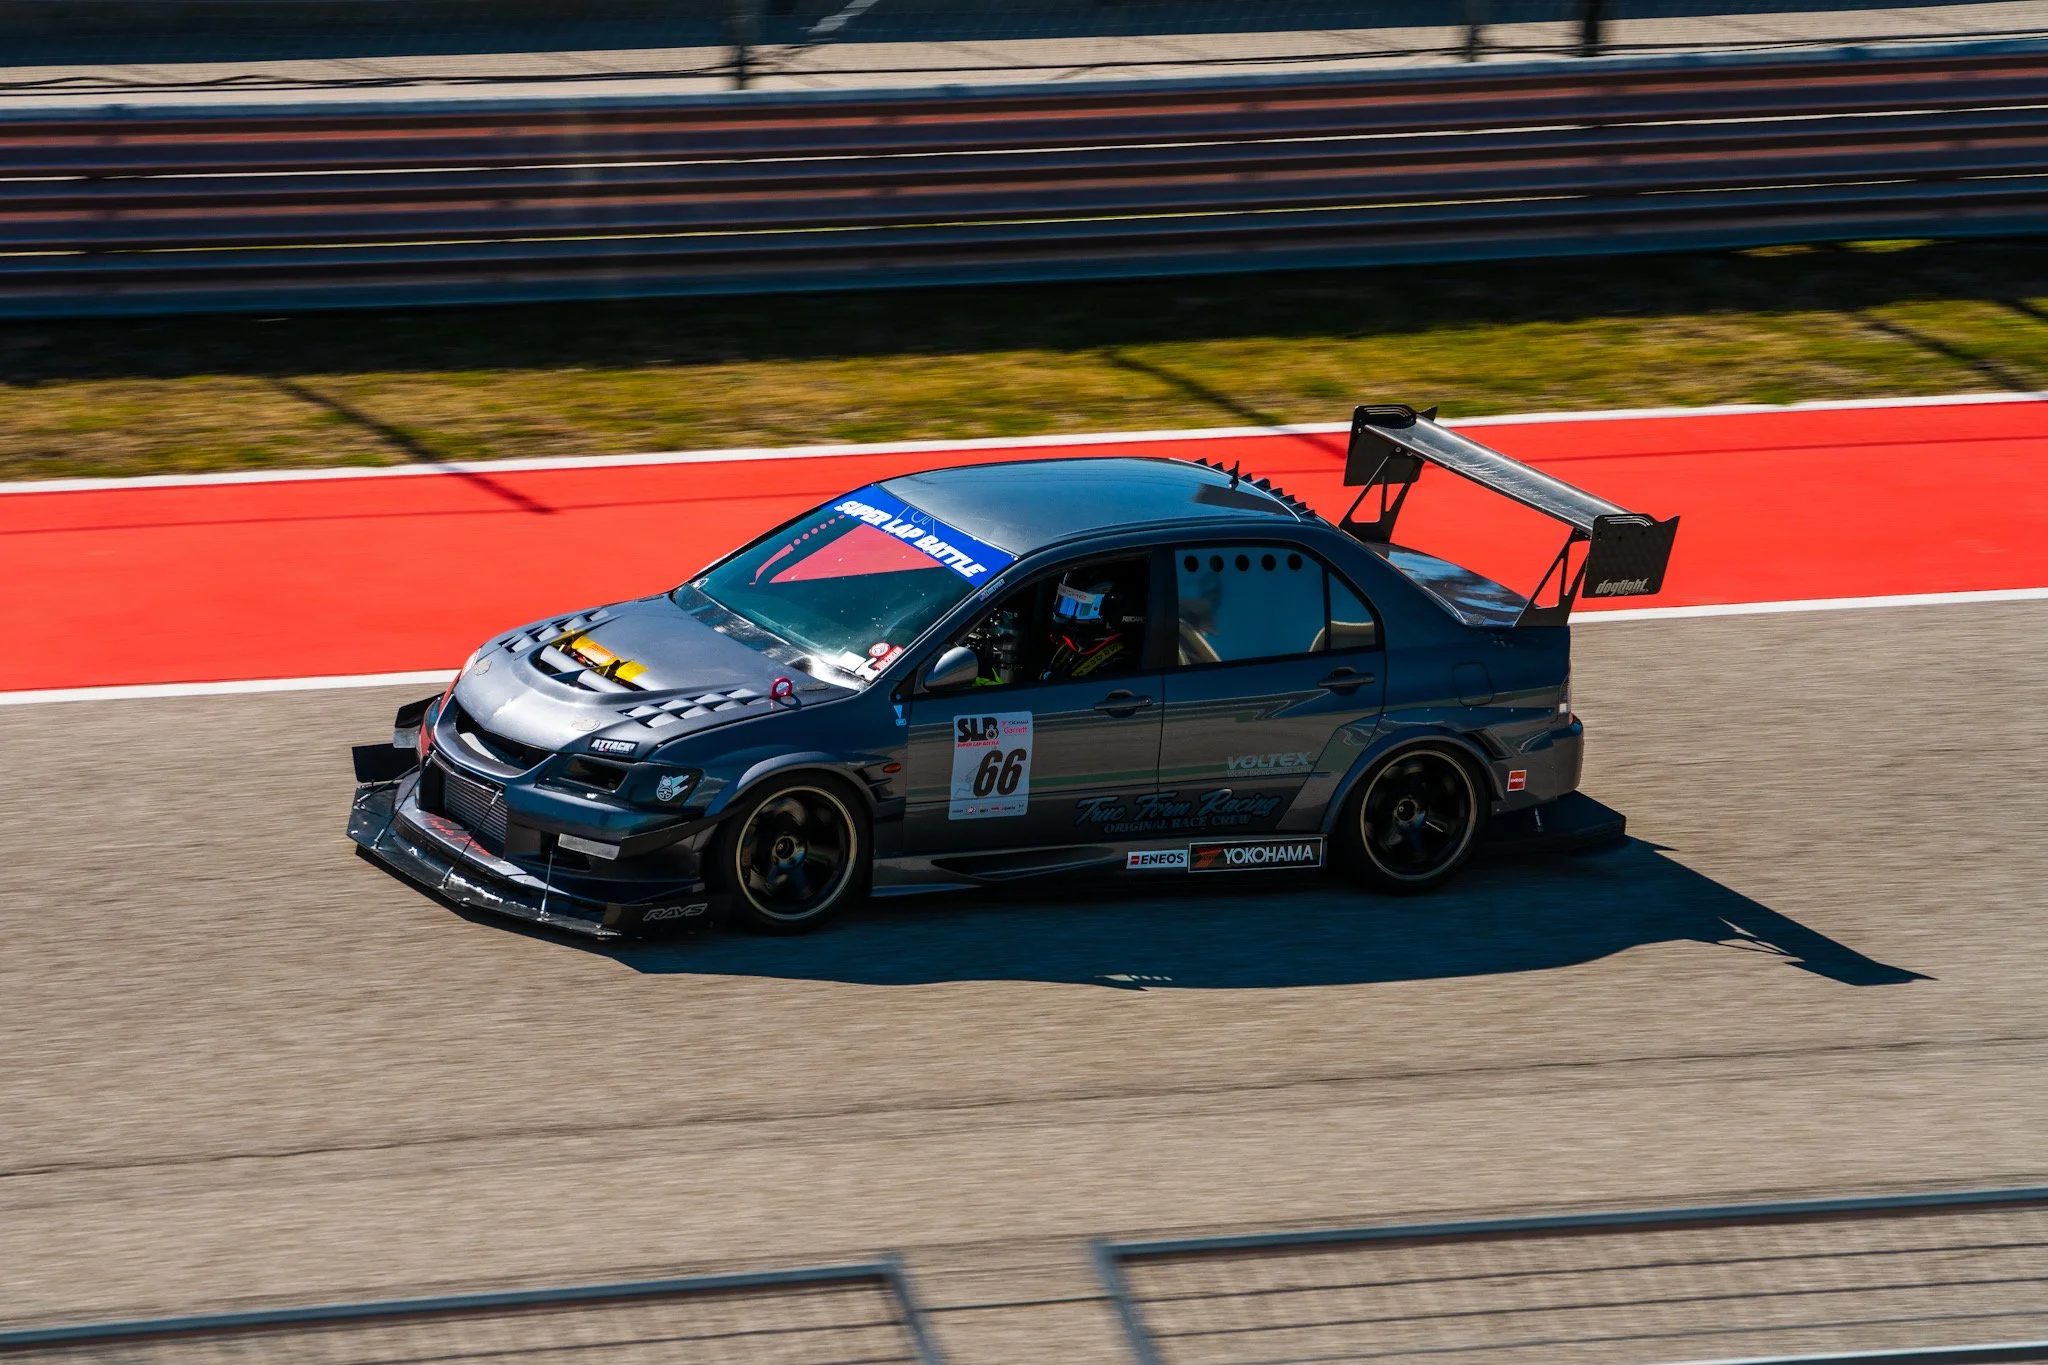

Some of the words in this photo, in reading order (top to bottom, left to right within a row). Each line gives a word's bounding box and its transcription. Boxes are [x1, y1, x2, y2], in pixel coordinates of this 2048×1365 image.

[834, 500, 893, 530] SUPER
[881, 518, 925, 541] LAP
[912, 534, 988, 579] BATTLE
[1595, 577, 1649, 597] dogfight
[957, 716, 999, 743] SLB
[591, 738, 637, 752] ATTACK!
[1227, 751, 1312, 770] VOLTEX
[973, 748, 1027, 797] 66
[1074, 795, 1128, 826] True
[1134, 790, 1192, 821] Form
[1198, 787, 1283, 818] Racing
[1103, 820, 1168, 835] ORIGINAL
[1171, 816, 1208, 829] RACE
[1211, 813, 1252, 826] CREW
[1140, 852, 1185, 865] ENEOS
[1223, 844, 1314, 865] YOKOHAMA
[642, 902, 709, 922] RAYS
